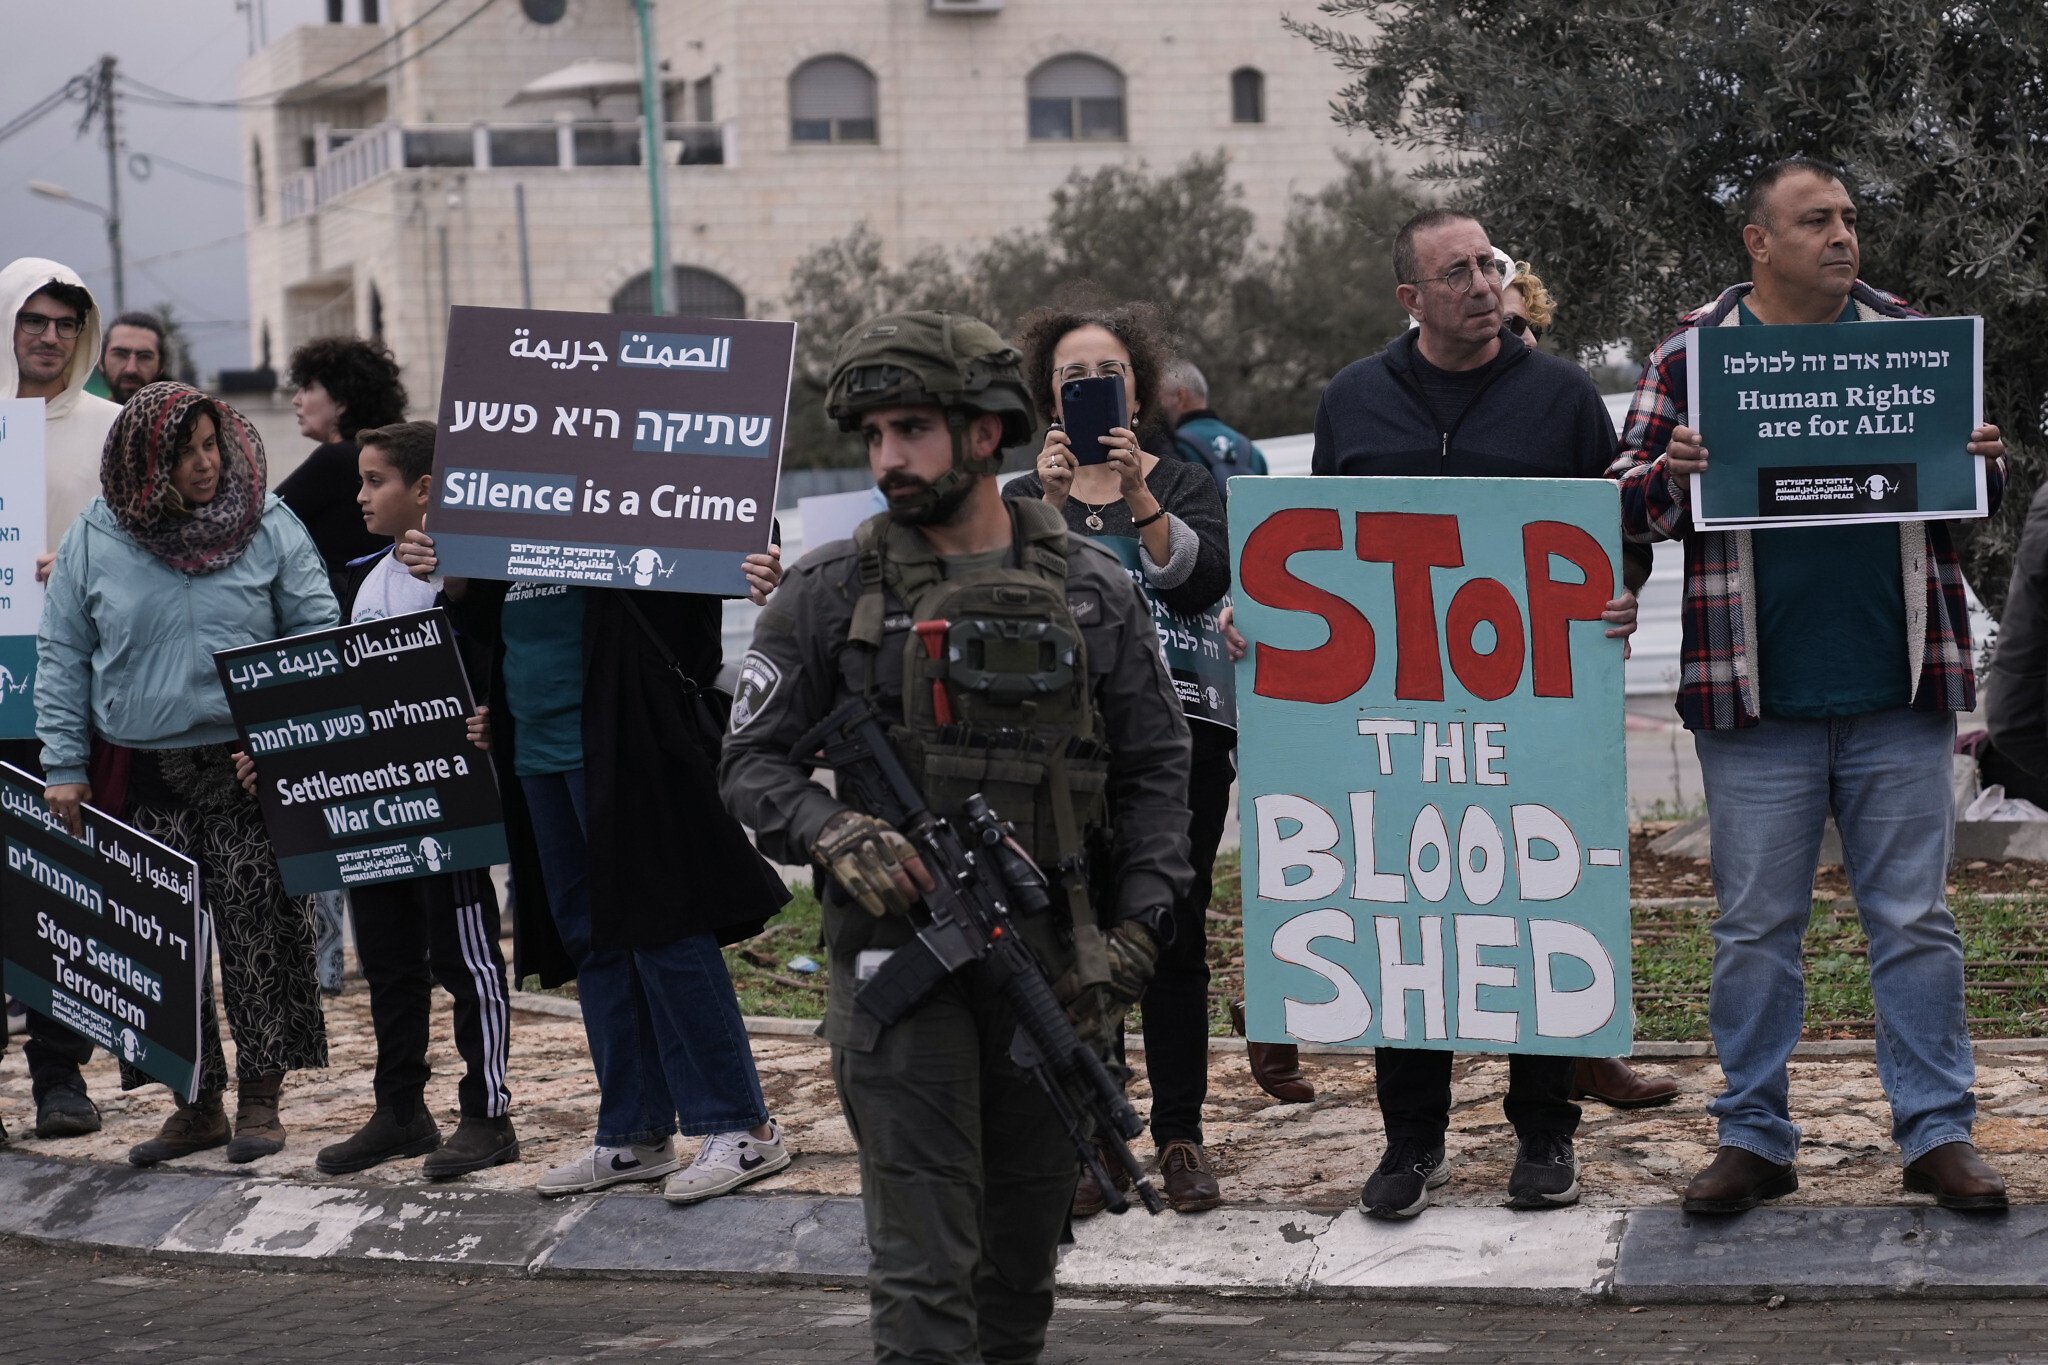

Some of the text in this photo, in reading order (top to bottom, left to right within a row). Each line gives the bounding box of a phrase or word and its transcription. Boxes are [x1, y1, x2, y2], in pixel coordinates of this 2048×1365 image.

[509, 328, 730, 371] الصمت جريمة
[1723, 350, 1949, 374] זכויות אדם זה לכולם!
[1738, 384, 1935, 412] Human Rights
[450, 401, 771, 451] שתיקה היא פשע
[1758, 413, 1914, 438] are for ALL!
[443, 471, 757, 522] Silence is a Crime
[508, 567, 612, 581] COMBATANTS FOR PEACE
[511, 544, 615, 558] לוחמים לשלום
[521, 590, 533, 599] FOR
[535, 585, 567, 597] PEACE
[1239, 508, 1614, 703] STOP
[229, 620, 441, 690] الاستيطان جريمة حرب
[1156, 622, 1219, 659] זה לכול
[249, 697, 463, 752] התנחליות פשע מלחמה
[1357, 718, 1509, 786] THE
[277, 755, 468, 805] Settlements are a
[323, 797, 440, 834] War Crime
[99, 841, 141, 883] إرهاب
[1252, 790, 1622, 905] BLOOD-
[146, 857, 192, 904] أوقفوا
[343, 865, 414, 883] COMBATANTS FOR PEACE
[8, 845, 187, 960] די לטרור המתנחלים
[37, 912, 161, 1002] Stop Settlers
[1271, 907, 1616, 1044] SHED
[53, 954, 145, 1030] Terrorism
